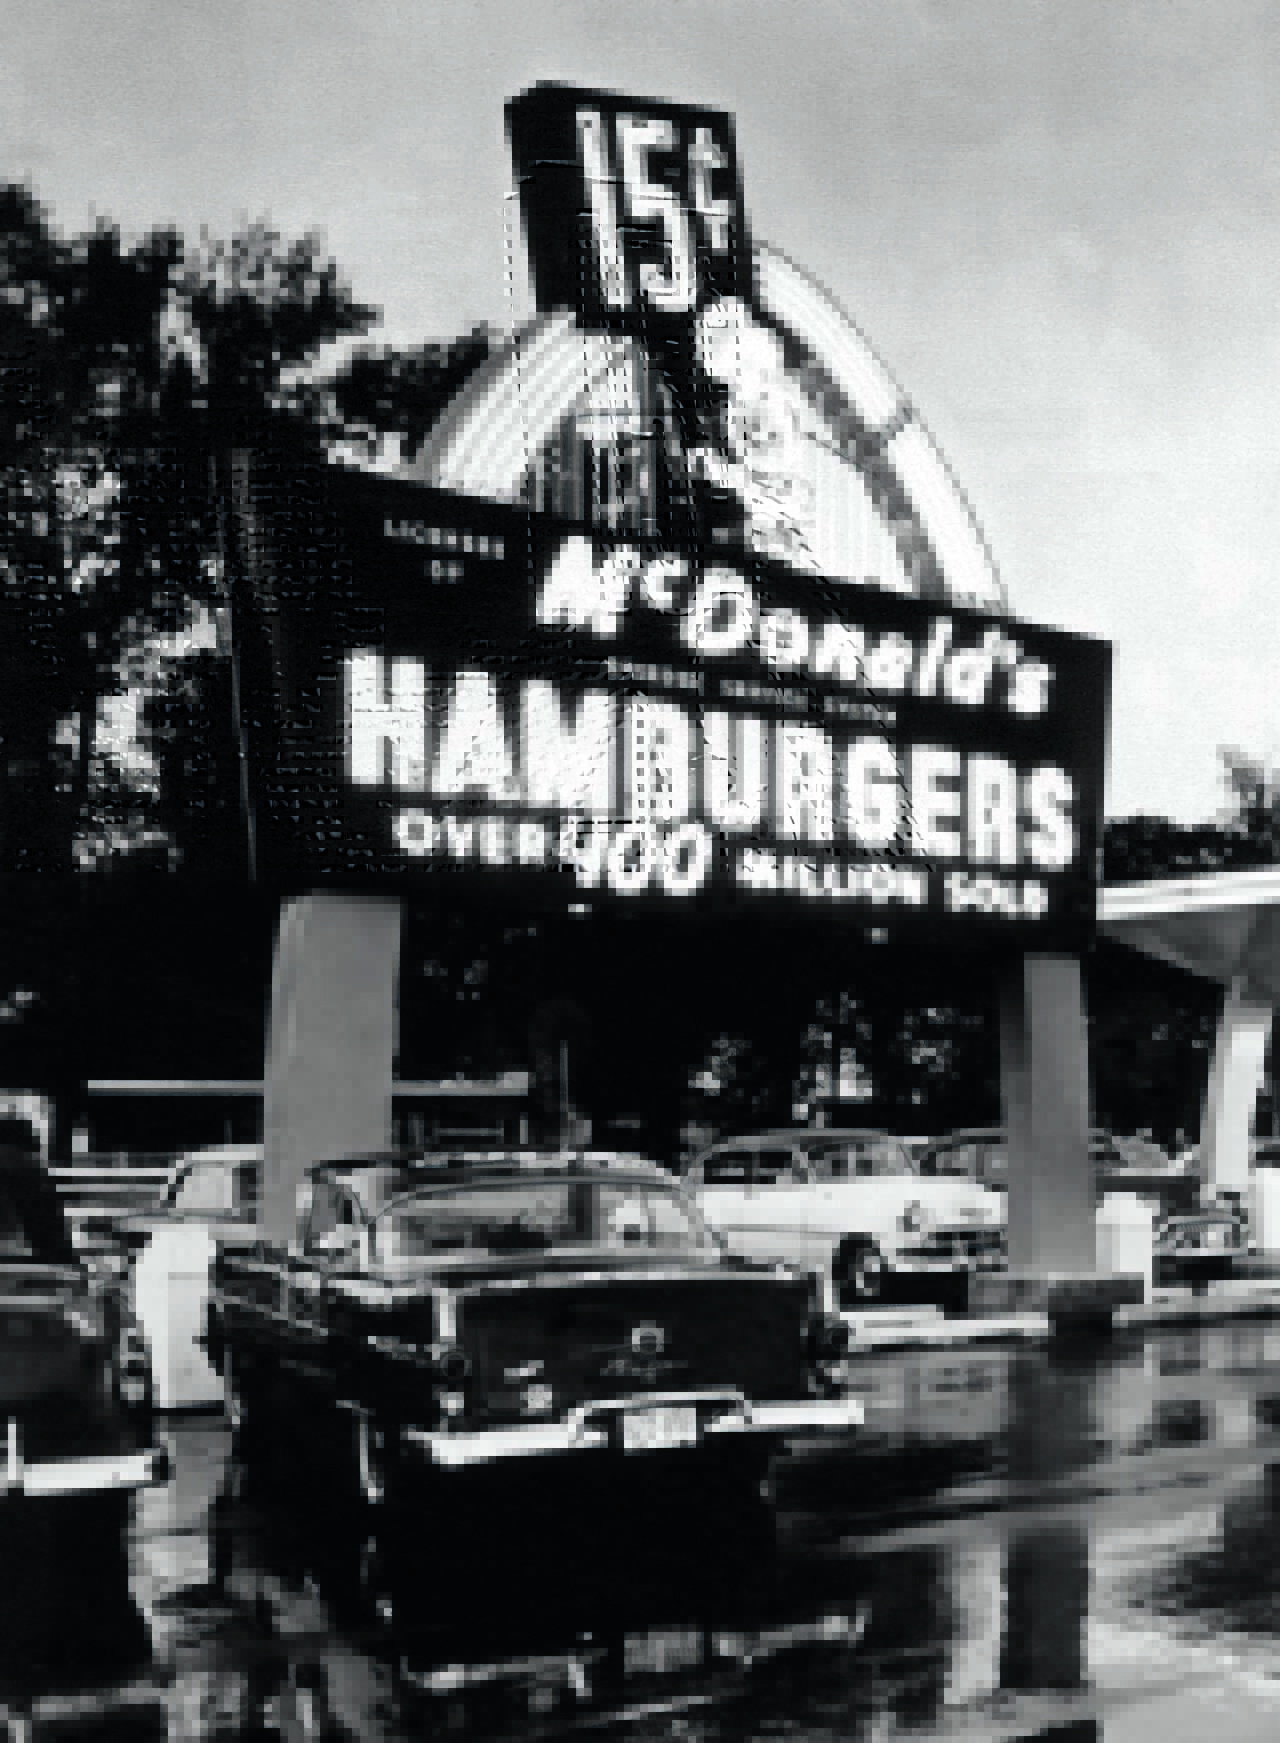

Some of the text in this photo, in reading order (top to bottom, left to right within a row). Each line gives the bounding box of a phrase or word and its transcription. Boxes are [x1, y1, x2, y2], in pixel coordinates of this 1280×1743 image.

[575, 109, 729, 312] 15¢
[535, 534, 1057, 714] McDonald's
[343, 646, 1082, 872] HAMBURGERS
[392, 808, 1049, 920] OVER 400 MILLION SOLD
